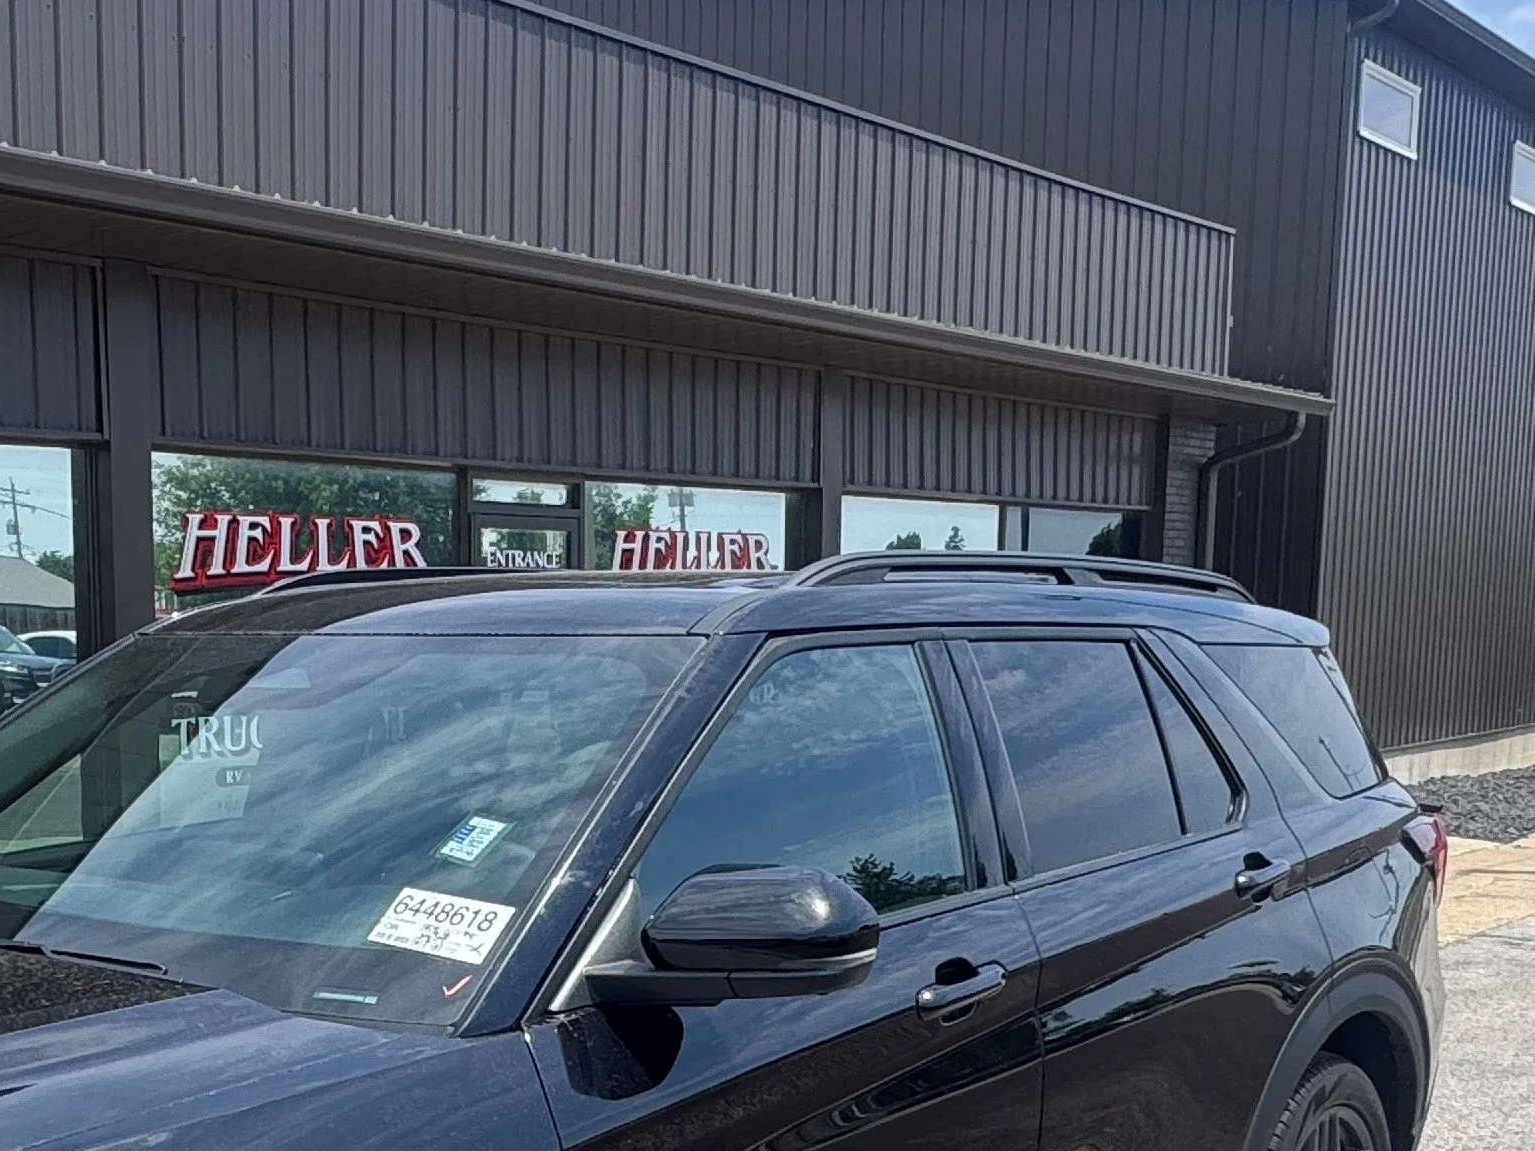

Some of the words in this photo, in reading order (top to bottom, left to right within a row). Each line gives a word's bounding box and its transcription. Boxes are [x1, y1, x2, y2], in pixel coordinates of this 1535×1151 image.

[172, 512, 428, 579] HELLER
[486, 545, 562, 569] ENTRANCE
[612, 529, 780, 572] HELLER
[392, 893, 499, 933] 6448618
